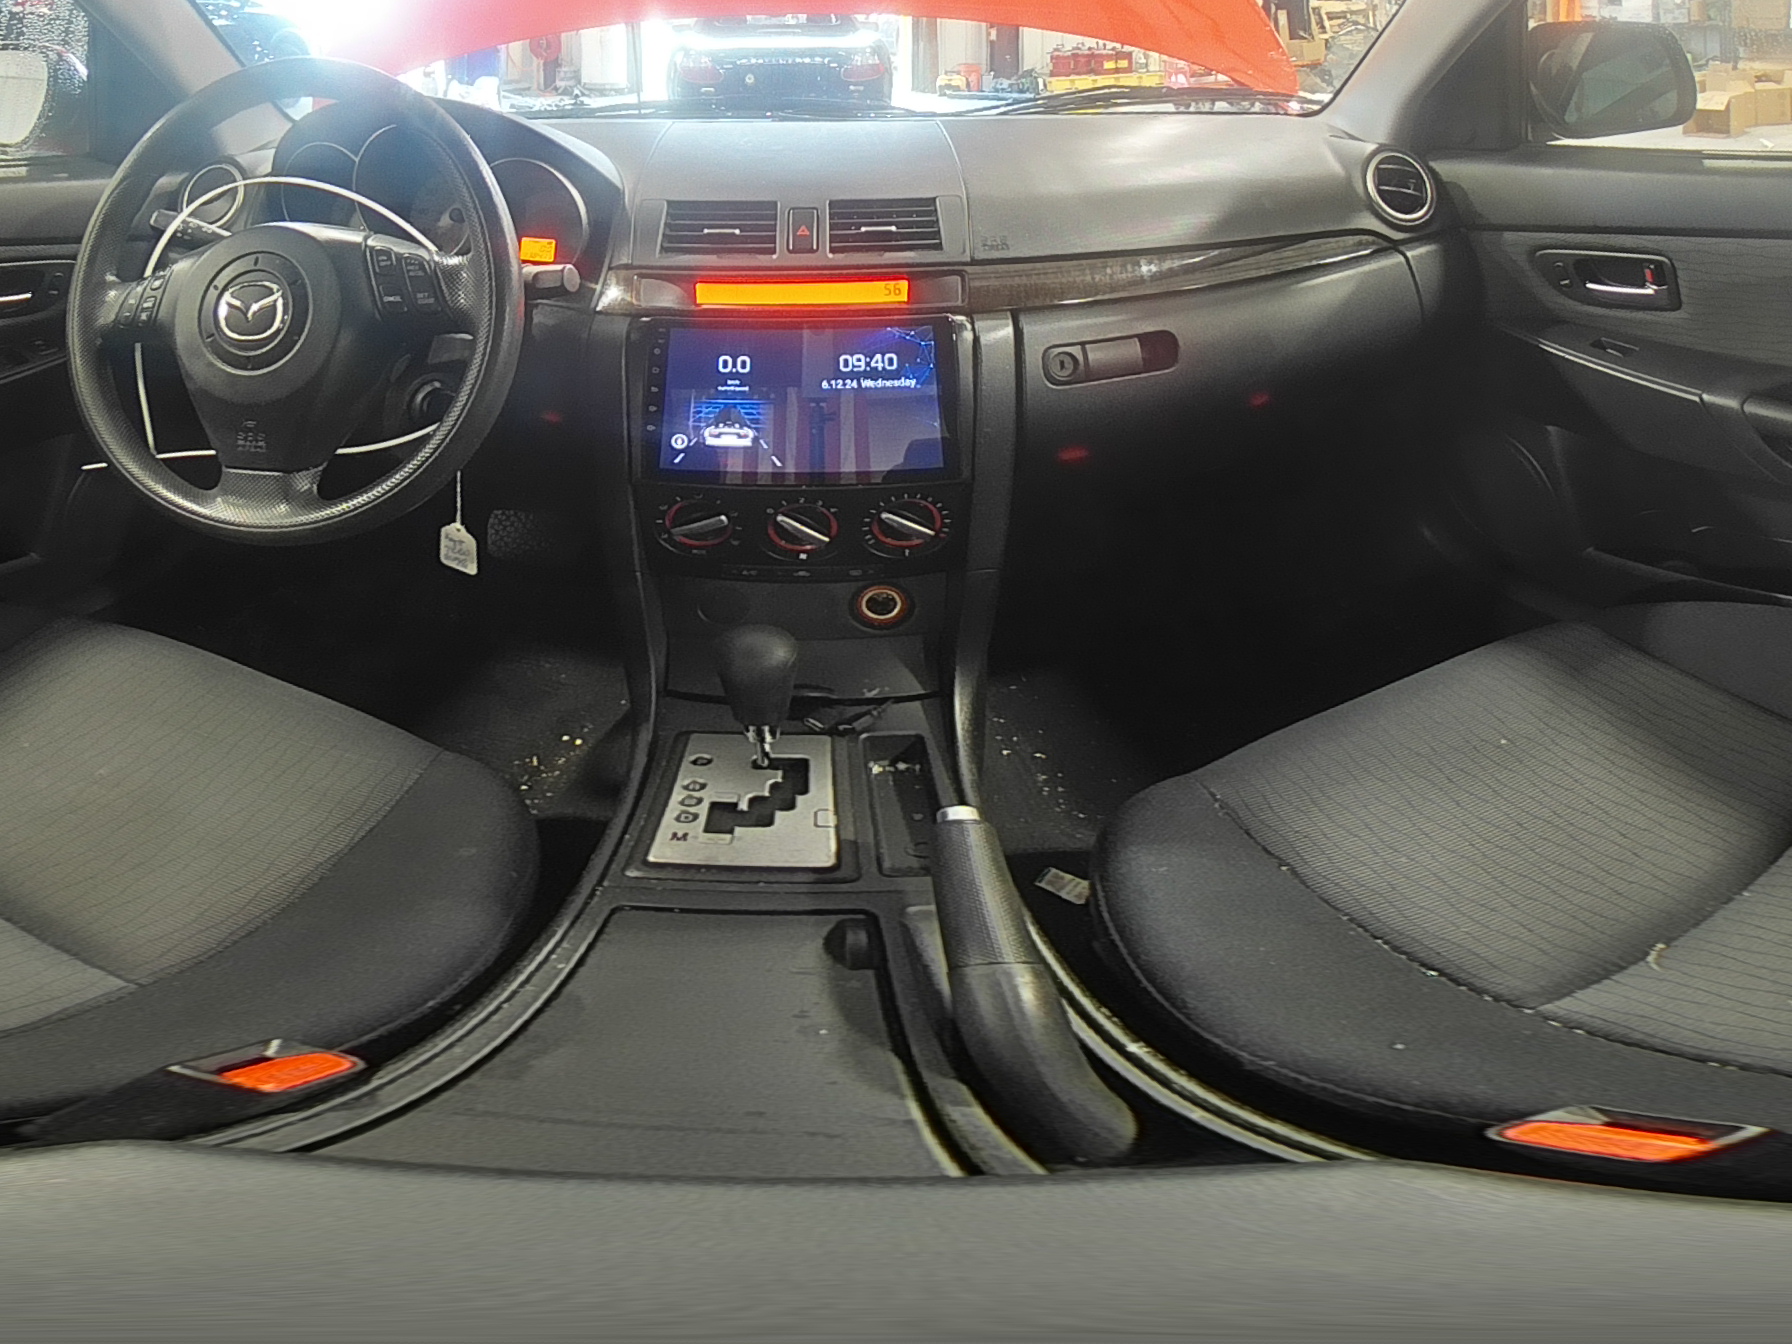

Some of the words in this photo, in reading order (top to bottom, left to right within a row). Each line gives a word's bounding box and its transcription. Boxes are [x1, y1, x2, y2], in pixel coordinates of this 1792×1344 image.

[883, 282, 902, 297] 56
[718, 355, 751, 373] 0.0
[839, 353, 898, 372] 09:40
[821, 379, 858, 390] 6.12.24
[860, 377, 917, 389] Wednesday
[669, 831, 689, 842] M
